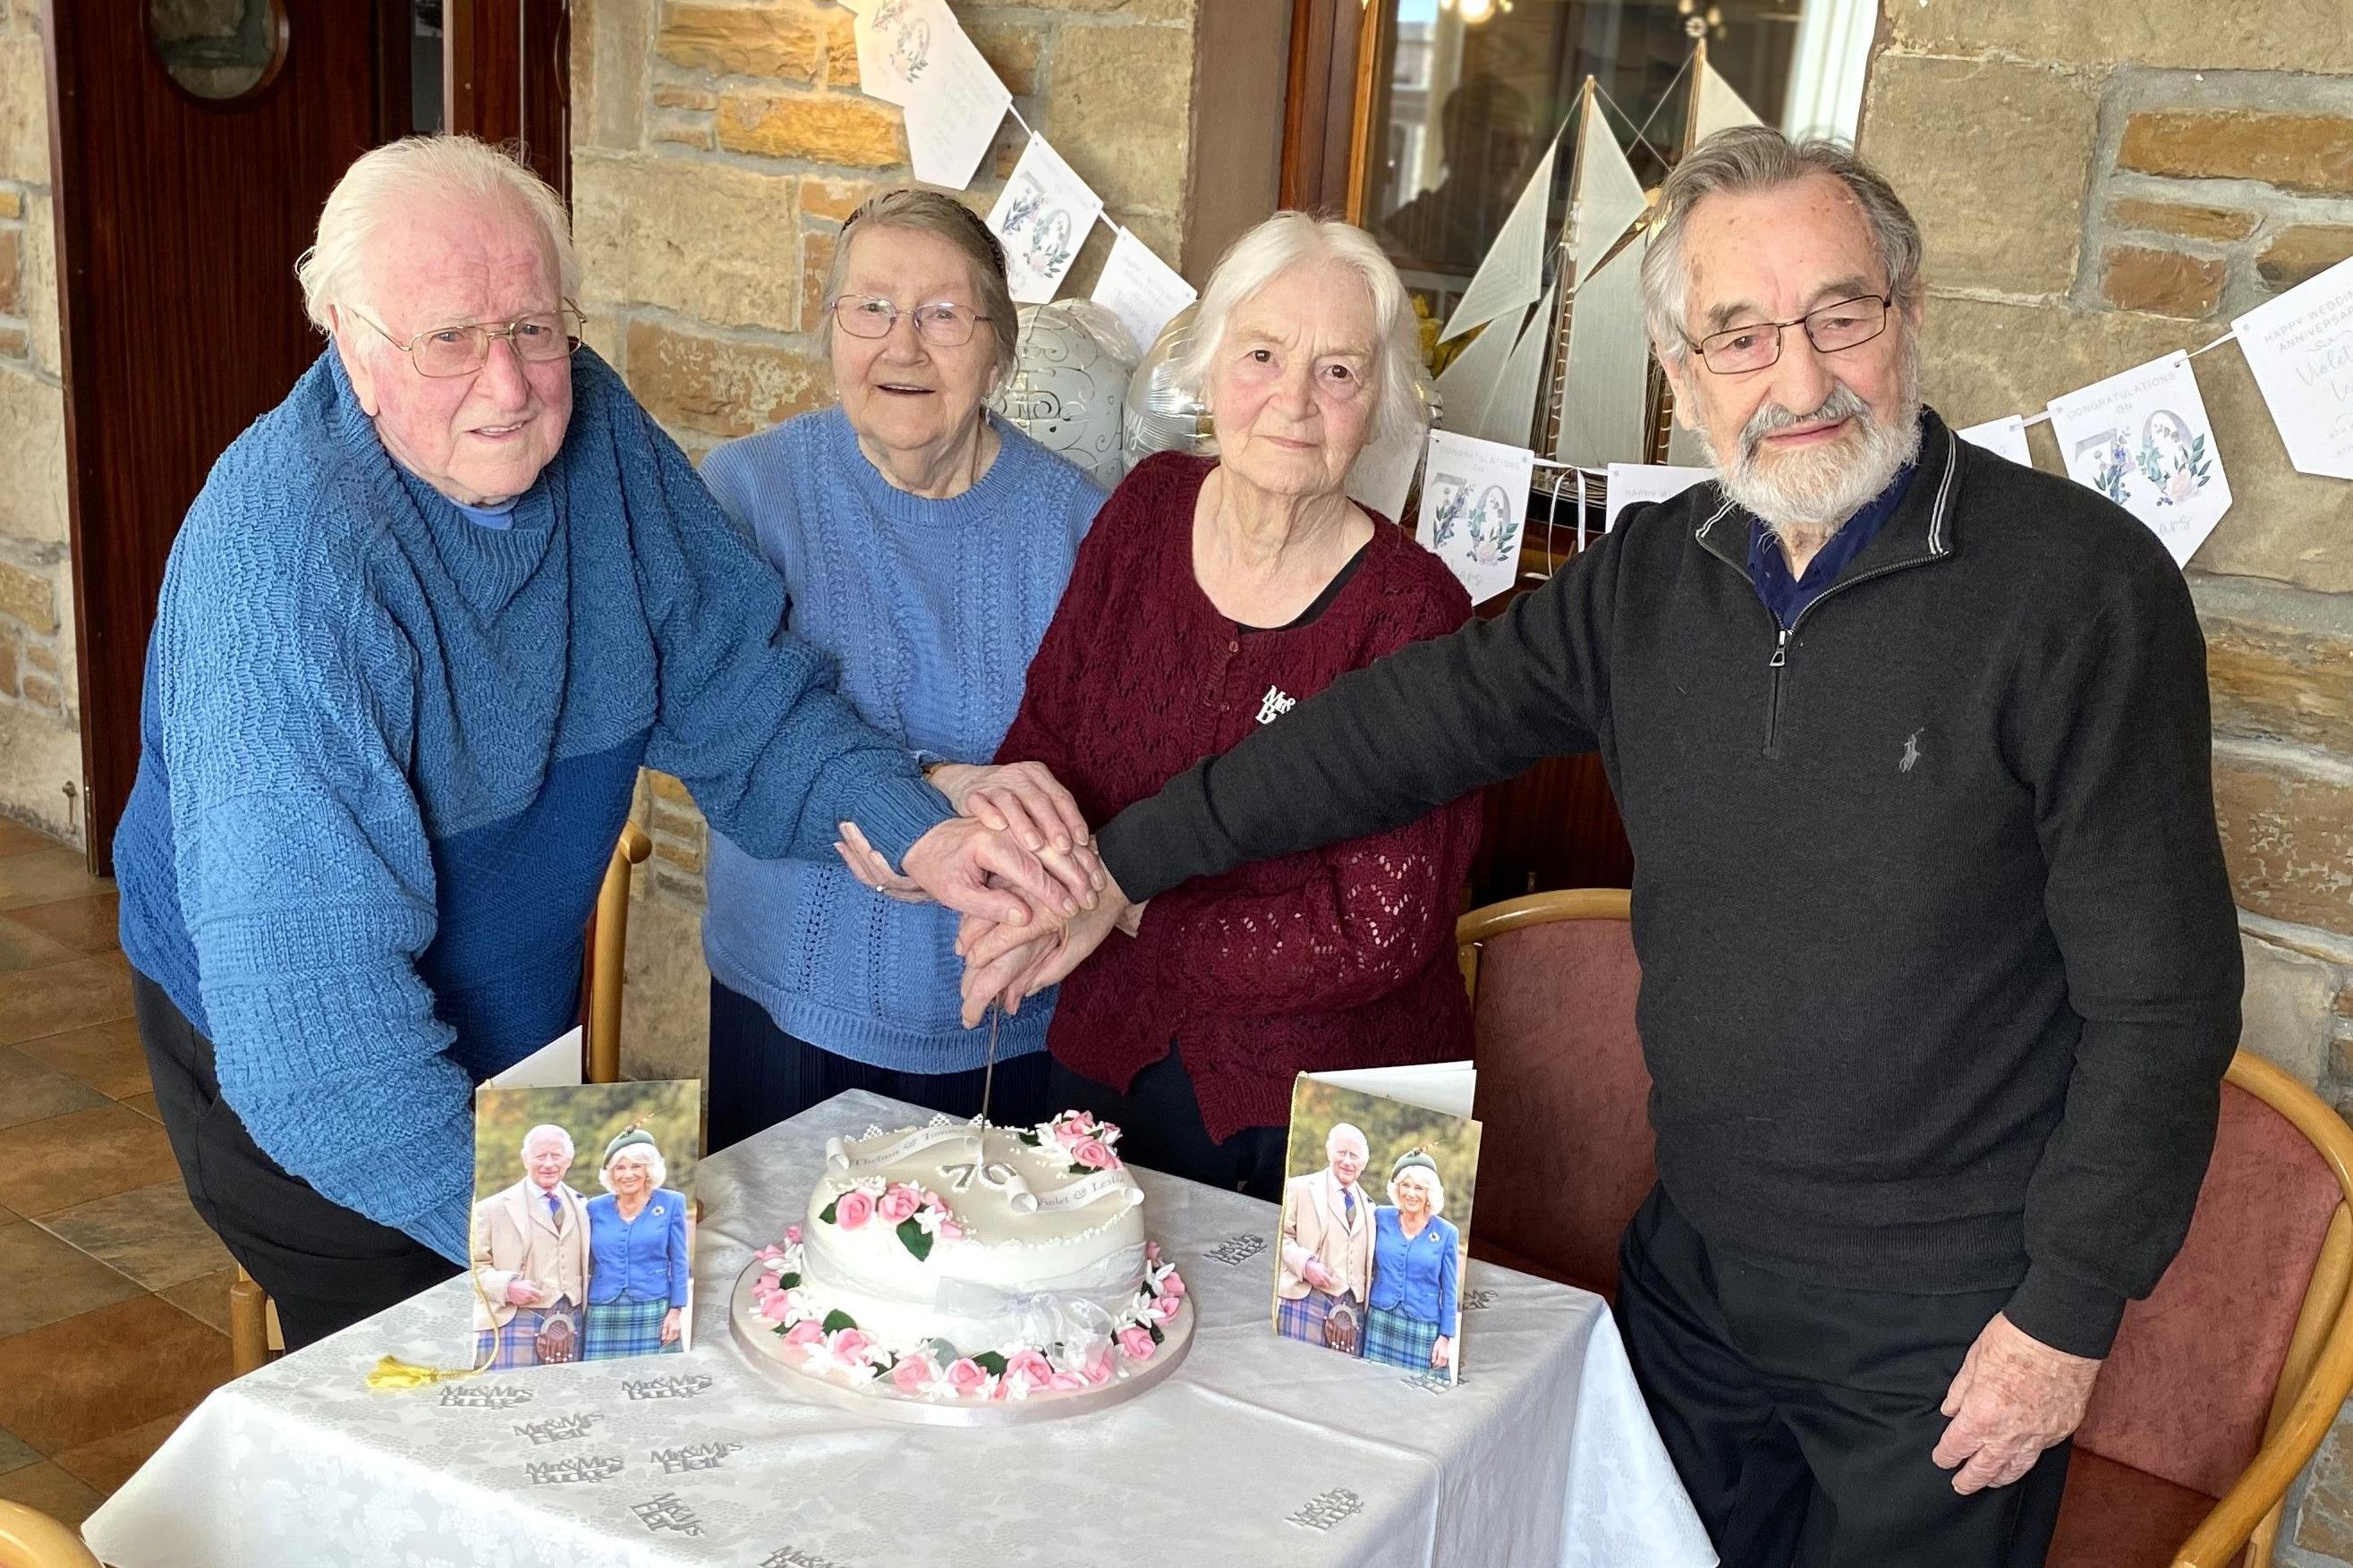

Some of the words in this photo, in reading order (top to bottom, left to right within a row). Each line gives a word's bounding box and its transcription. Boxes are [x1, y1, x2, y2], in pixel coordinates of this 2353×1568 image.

[2264, 317, 2304, 344] HAPPY
[2307, 291, 2353, 319] WEDDIN
[2280, 306, 2353, 352] ANNIVERSAR
[2066, 370, 2178, 420] CONGRATULATIONS
[2116, 402, 2134, 414] ON
[938, 1161, 1017, 1191] 70
